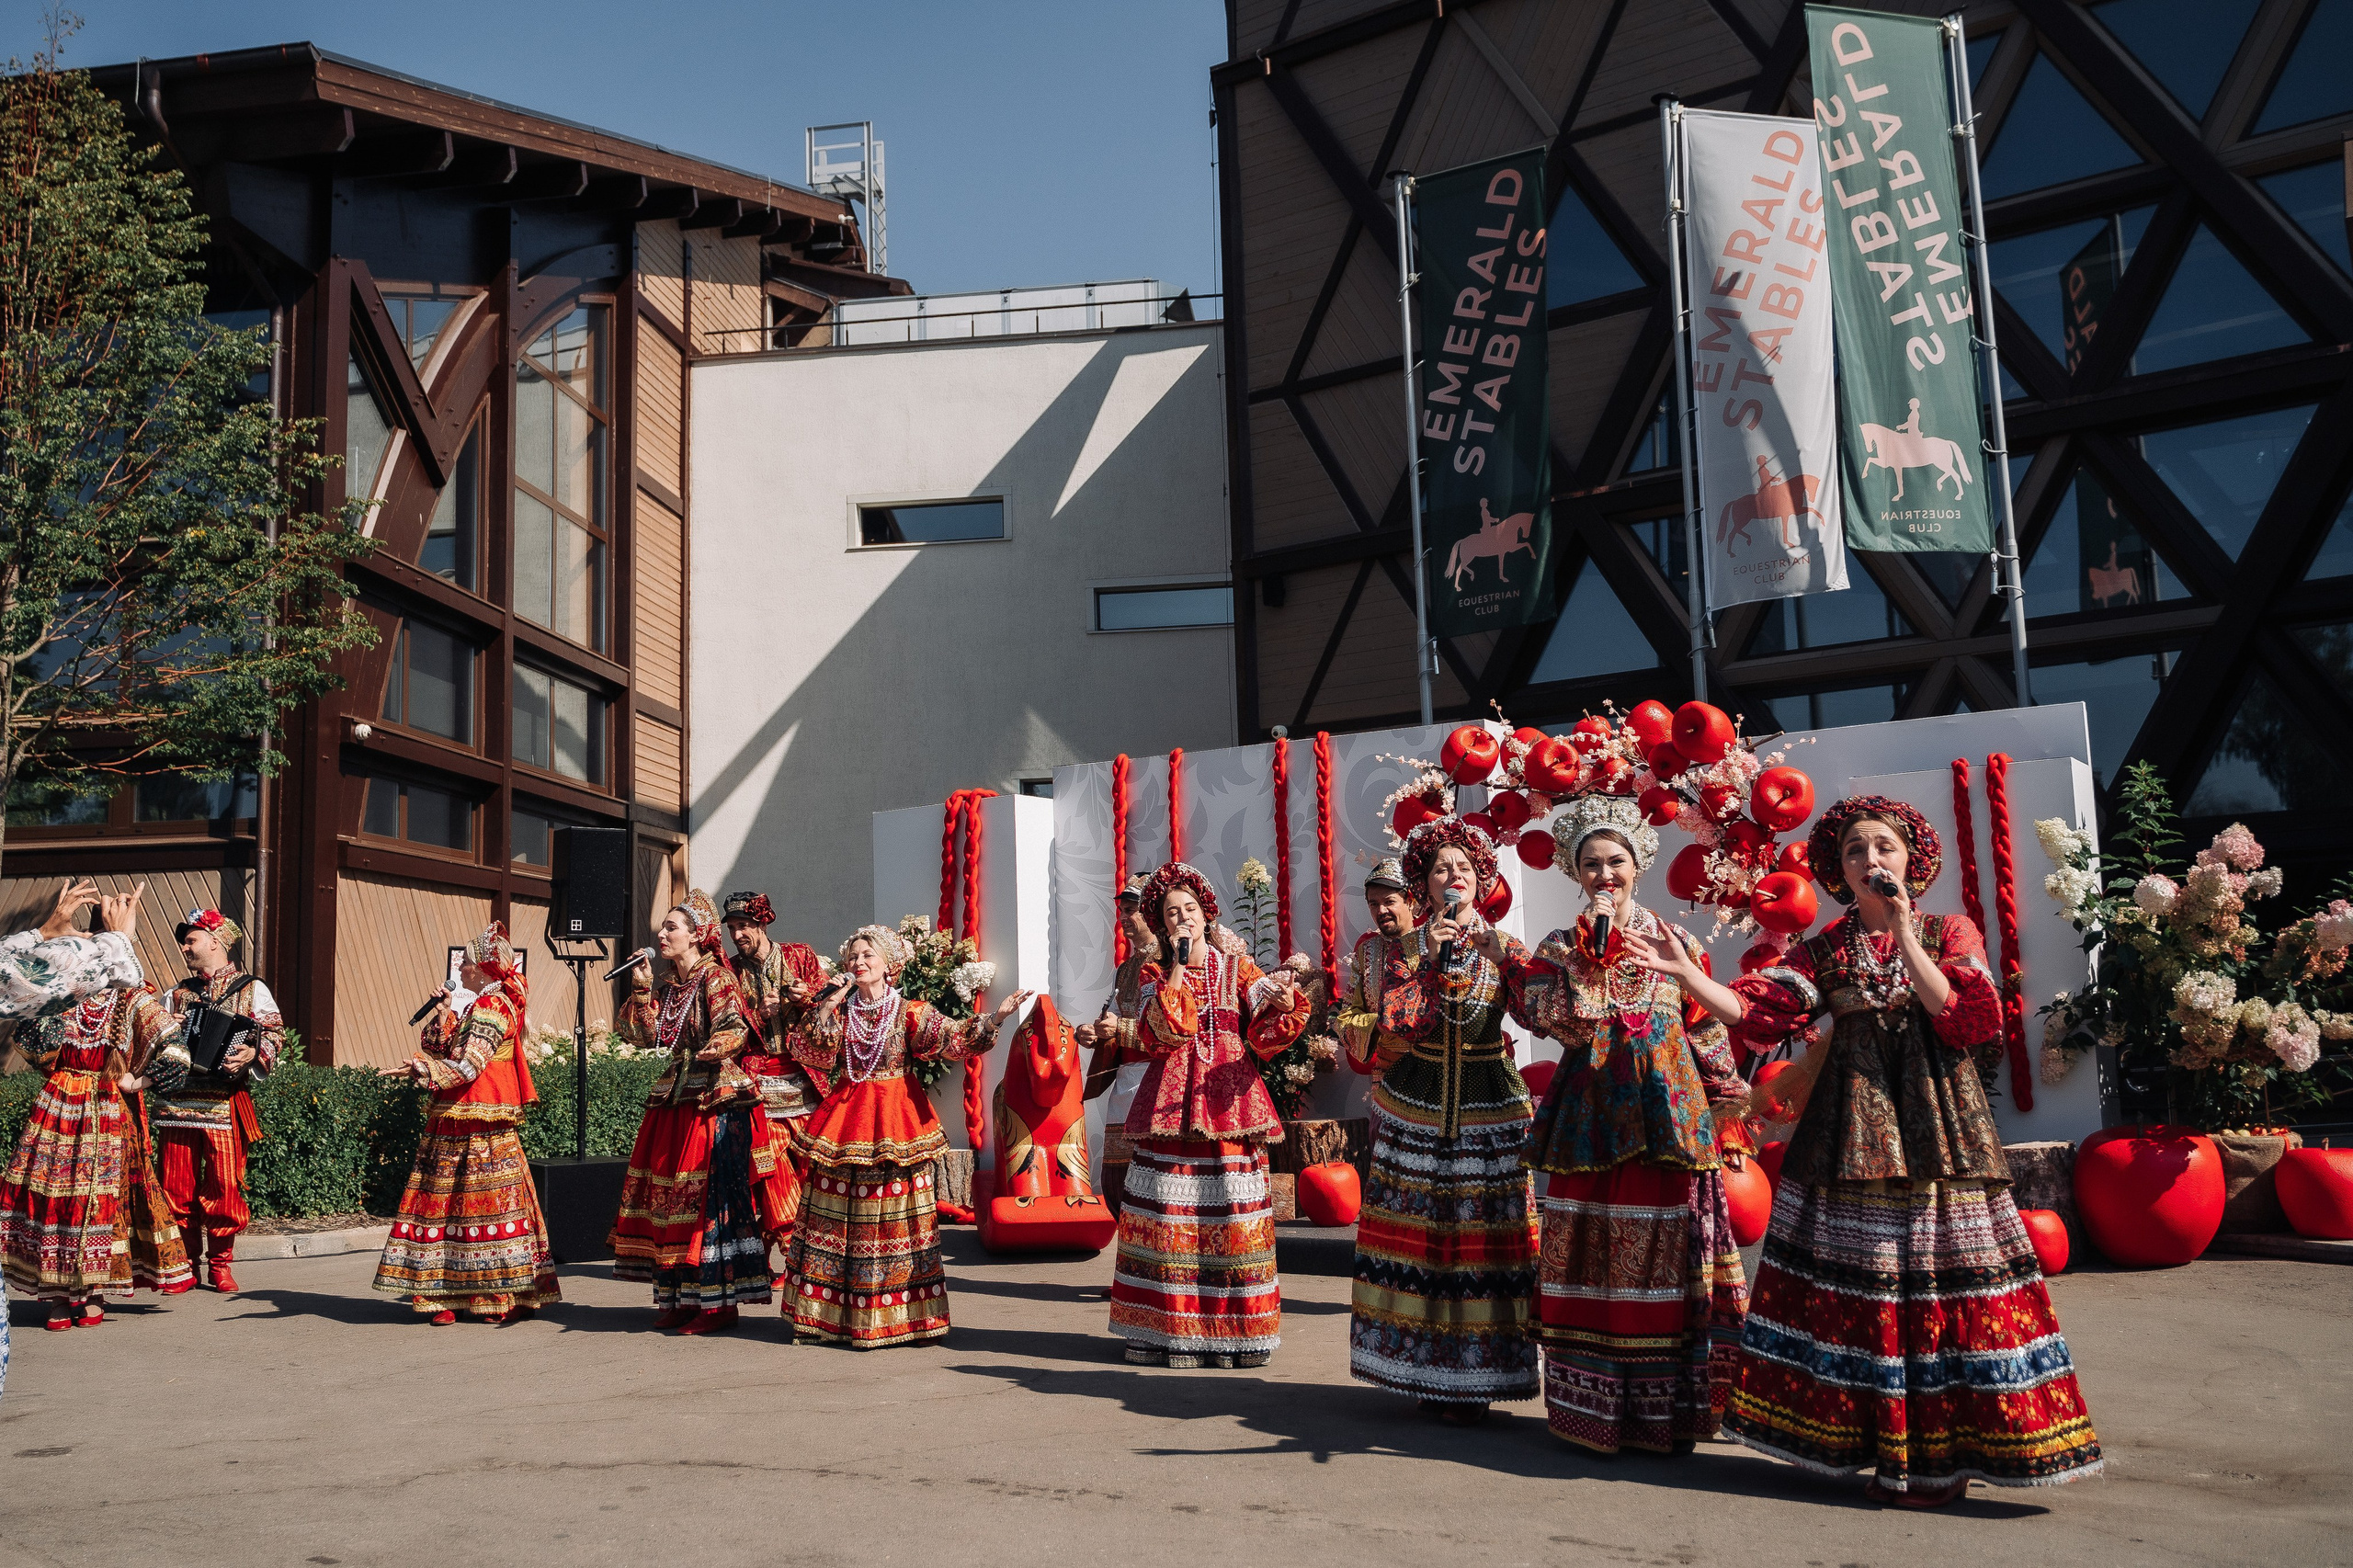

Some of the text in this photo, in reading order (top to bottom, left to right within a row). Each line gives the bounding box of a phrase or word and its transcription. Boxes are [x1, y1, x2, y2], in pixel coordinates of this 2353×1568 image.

[1423, 168, 1524, 442] EMERALD
[1693, 130, 1805, 393] EMERALD
[1722, 187, 1826, 431] STABLES
[1453, 228, 1547, 476] STABLES
[1458, 589, 1520, 608] EQUESTRIAN
[1474, 604, 1500, 616] CLUB
[1733, 555, 1811, 575] EQUESTRIAN
[1754, 572, 1785, 585] CLUB
